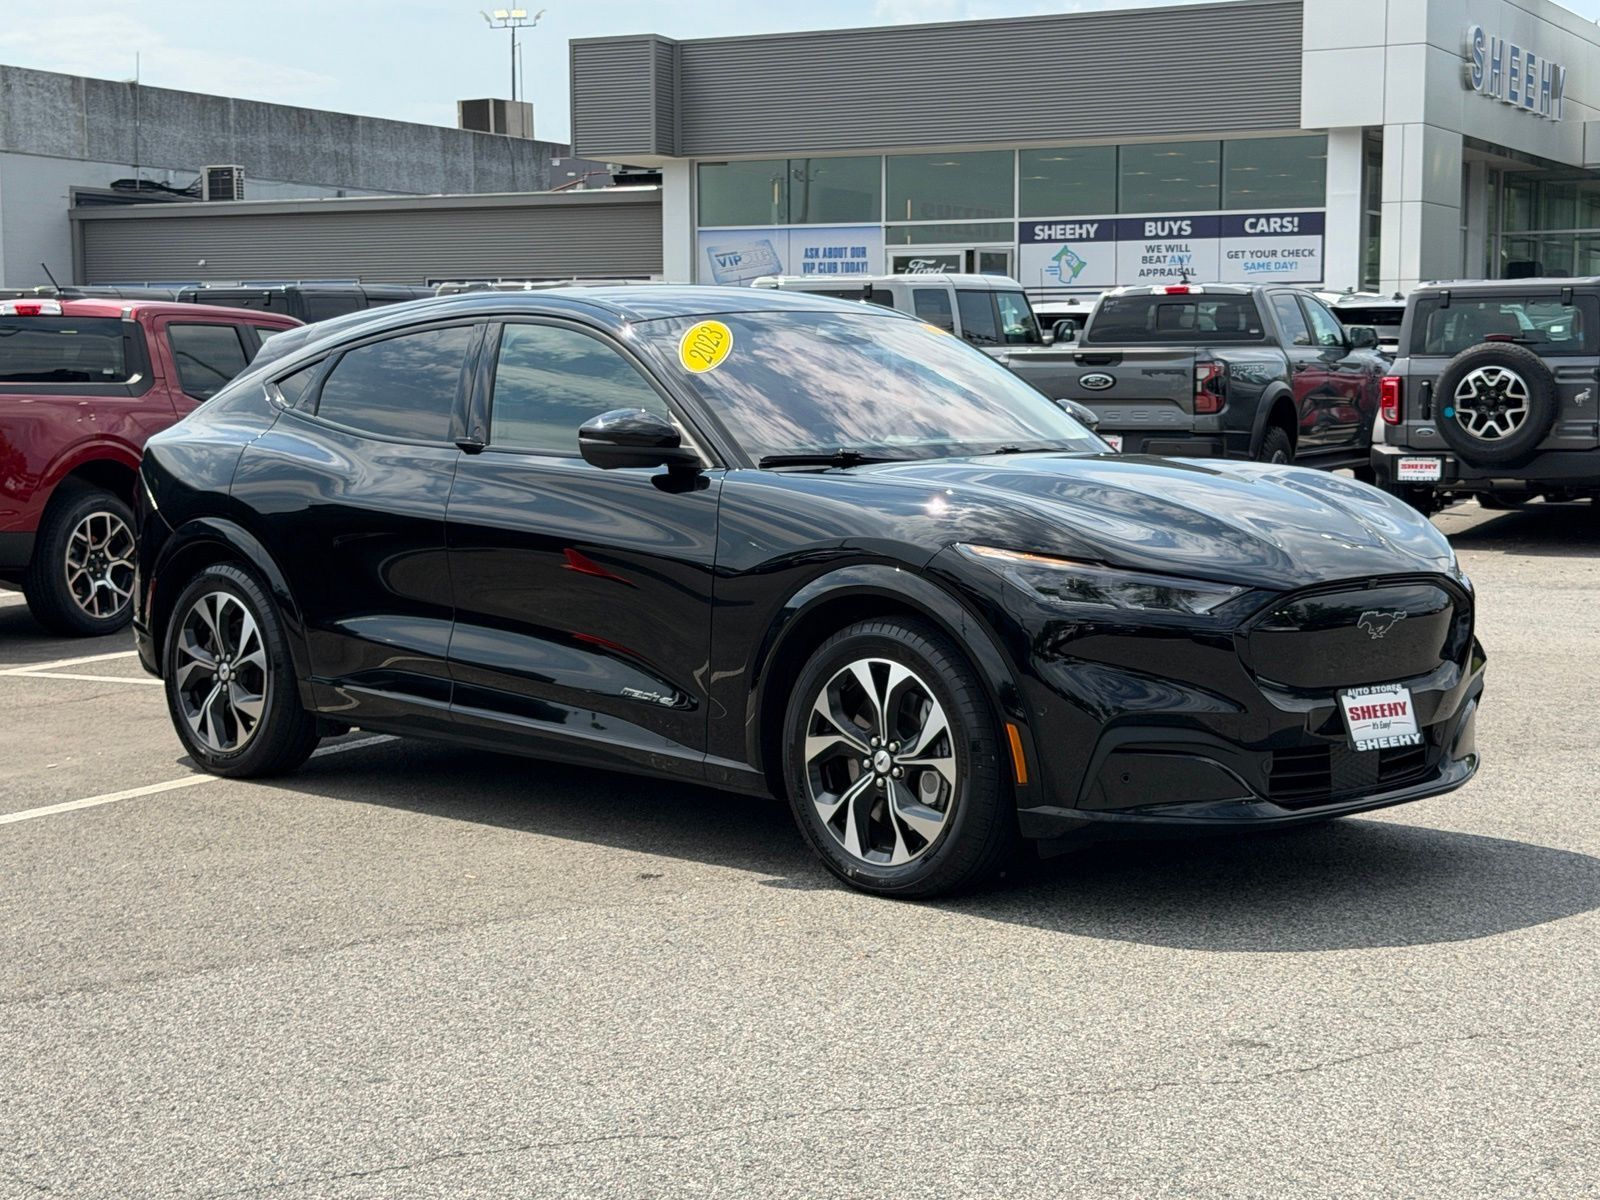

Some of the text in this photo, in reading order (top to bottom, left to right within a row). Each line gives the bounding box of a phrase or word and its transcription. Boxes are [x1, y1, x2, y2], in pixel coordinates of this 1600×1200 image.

[1464, 25, 1566, 121] SHEEHY
[1034, 217, 1299, 240] SHEEHY BUYS CARS!
[804, 246, 866, 259] ASK ABOUT OUR
[1145, 244, 1191, 254] WE WILL
[1226, 249, 1315, 259] GET YOUR CHECK
[716, 255, 742, 267] VIP
[1141, 255, 1192, 264] BEAT ANY
[1243, 261, 1298, 271] SAME DAY!
[802, 261, 868, 274] VIP CLUB TODAY!
[905, 259, 947, 274] Ford
[1139, 268, 1197, 277] APPRAISAL
[689, 326, 723, 364] 2023
[1103, 410, 1177, 422] GER
[1347, 684, 1402, 697] AUTO STORES
[1348, 701, 1407, 721] SHEEHY
[1356, 733, 1420, 752] SHEEHY
